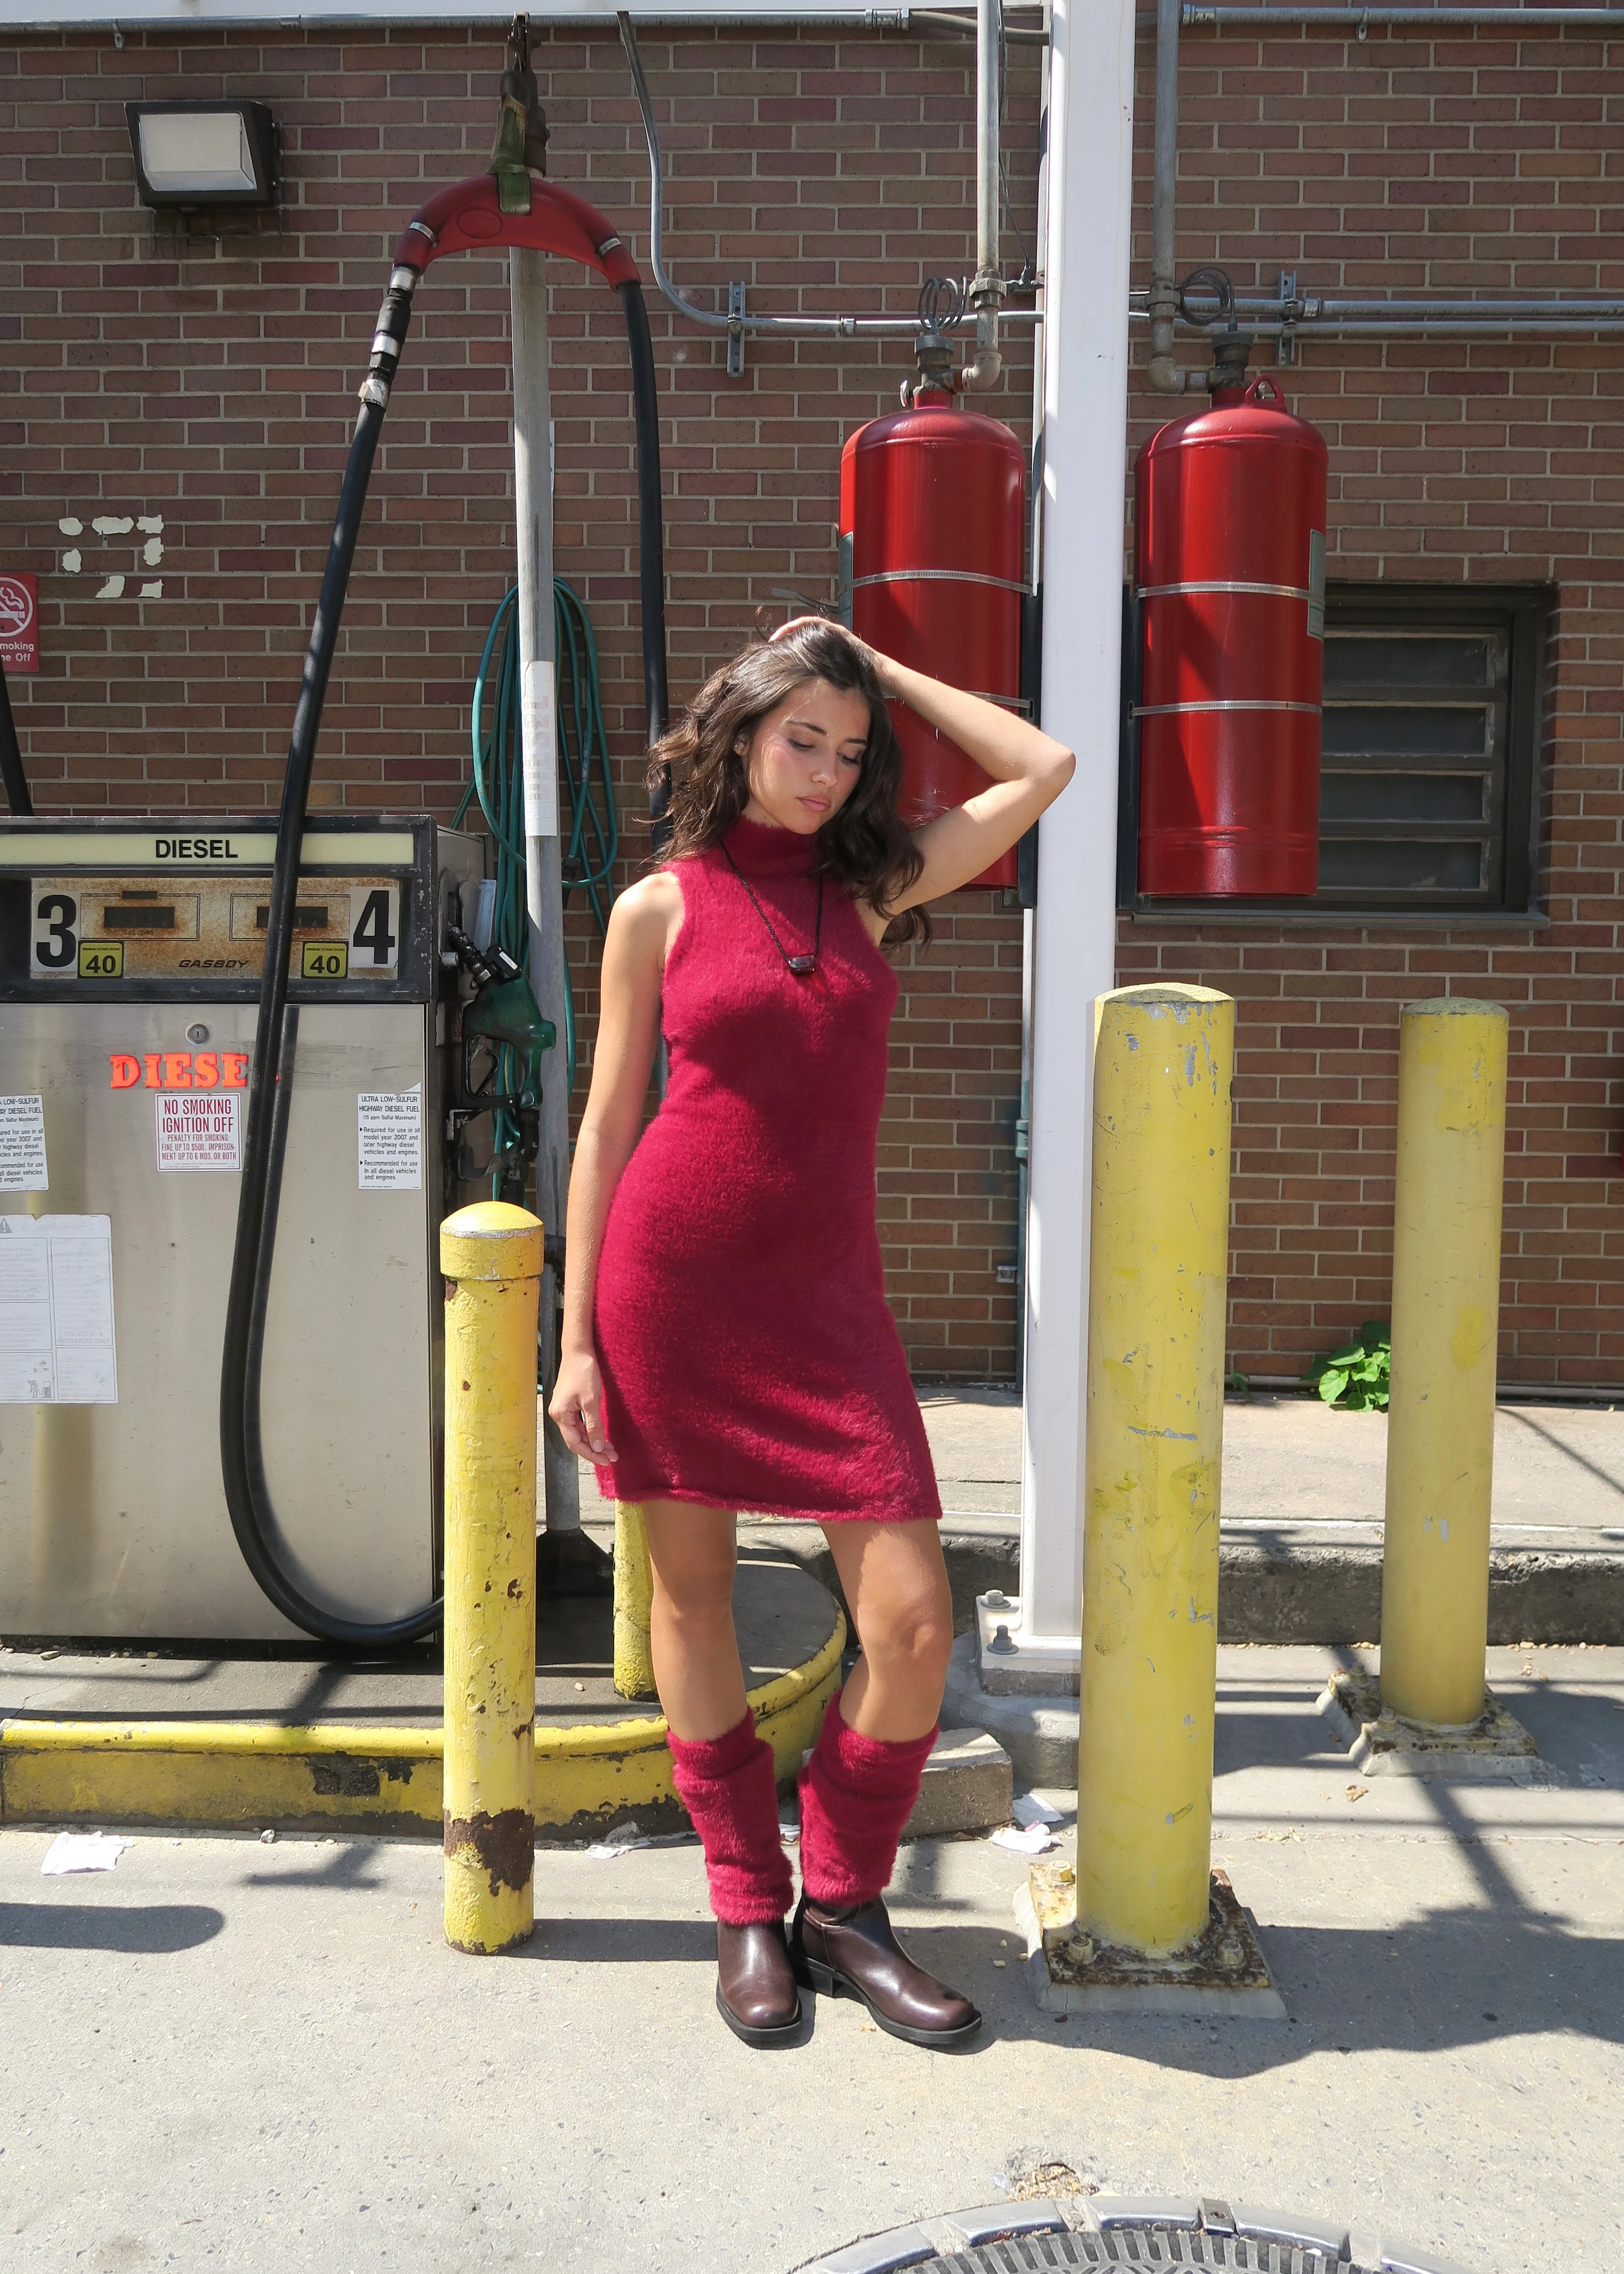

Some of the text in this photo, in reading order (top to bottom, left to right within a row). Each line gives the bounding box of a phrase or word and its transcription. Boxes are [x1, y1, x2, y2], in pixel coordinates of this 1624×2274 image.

[0, 641, 35, 652] moking
[16, 653, 31, 662] Off
[156, 839, 238, 859] DIESEL
[36, 894, 77, 968] 3
[353, 890, 396, 965] 4
[86, 955, 116, 974] 40
[310, 955, 340, 974] 40
[110, 1053, 248, 1088] DIESE
[164, 1099, 231, 1115] NO SMOKING
[163, 1117, 234, 1132] IGNITION OFF
[191, 1143, 206, 1152] $500,
